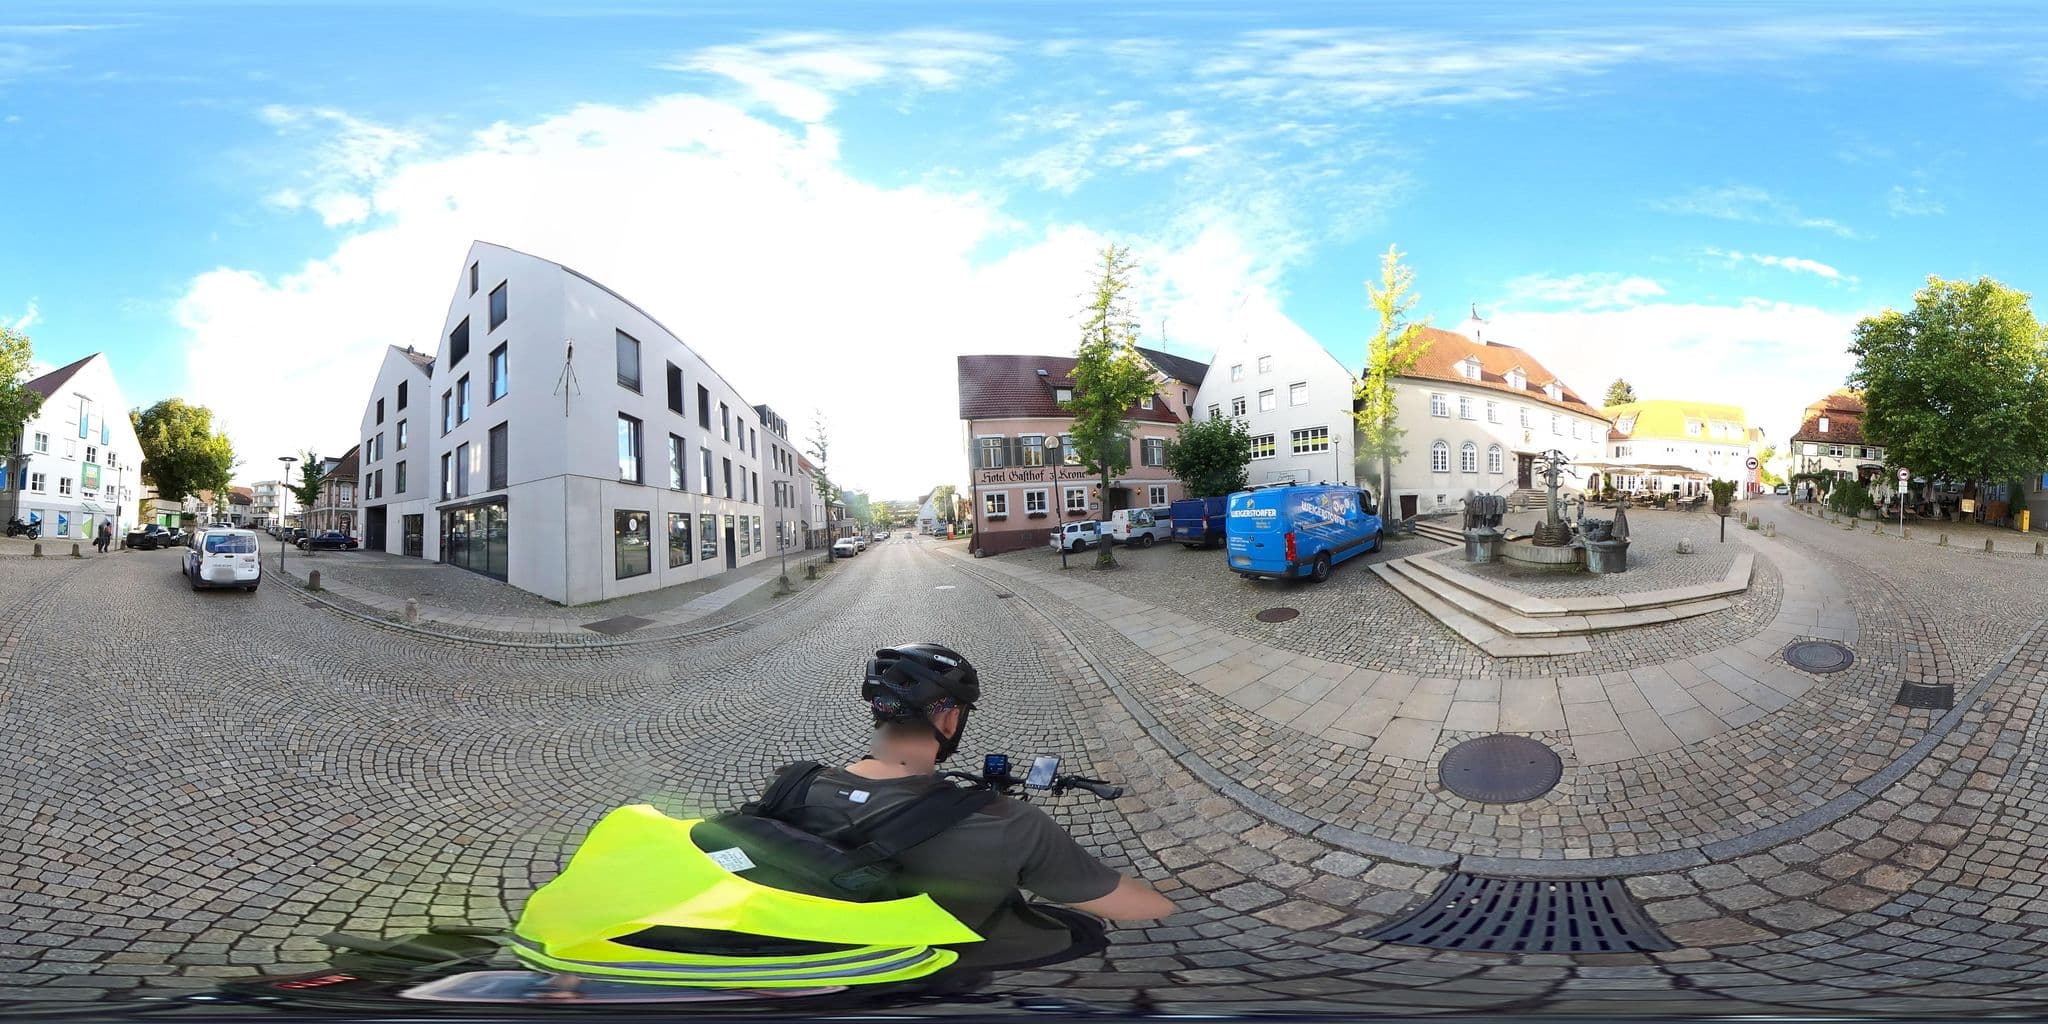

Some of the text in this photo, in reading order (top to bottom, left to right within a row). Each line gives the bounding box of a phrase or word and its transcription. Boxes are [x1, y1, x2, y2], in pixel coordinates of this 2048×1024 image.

[981, 471, 1006, 483] Hotel
[1008, 468, 1044, 482] Gasthof
[1058, 469, 1086, 480] Krone
